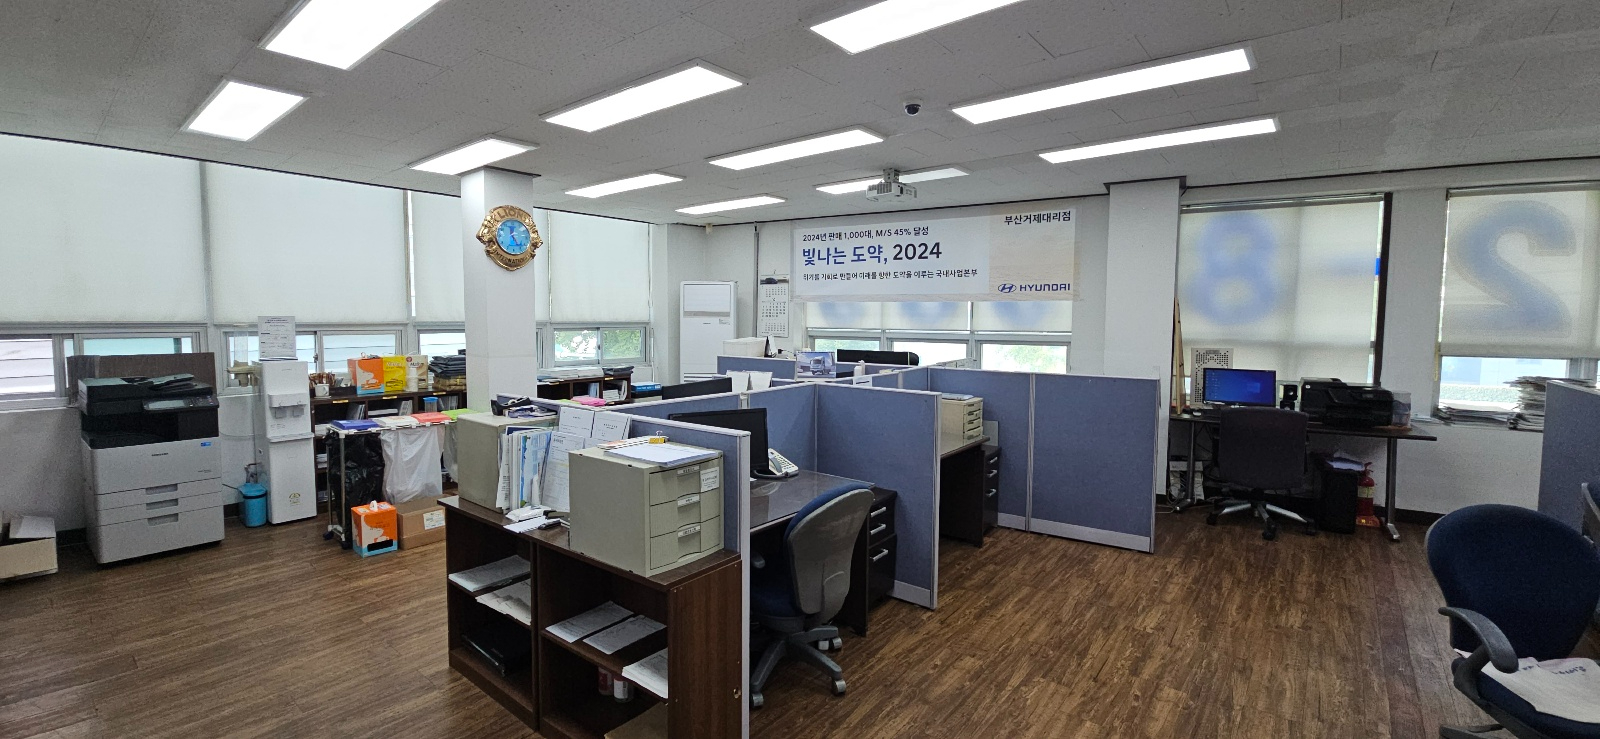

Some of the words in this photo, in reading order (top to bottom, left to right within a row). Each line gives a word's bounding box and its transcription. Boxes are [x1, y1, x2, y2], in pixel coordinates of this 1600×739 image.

[1004, 211, 1071, 226] 부산거제대리점
[802, 232, 827, 242] 2024년
[828, 231, 843, 241] 판매
[844, 229, 874, 240] 1,000대,
[876, 228, 892, 237] M/S
[893, 228, 912, 237] 45%
[913, 226, 929, 236] 달성
[802, 247, 847, 266] 빛나는
[850, 244, 888, 265] 도약,
[892, 241, 942, 261] 2024
[839, 272, 858, 281] 만들어
[892, 270, 912, 279] 도약을
[913, 269, 935, 279] 이루는
[936, 268, 978, 278] 국내사업본부
[1019, 283, 1071, 292] HYUNDAI
